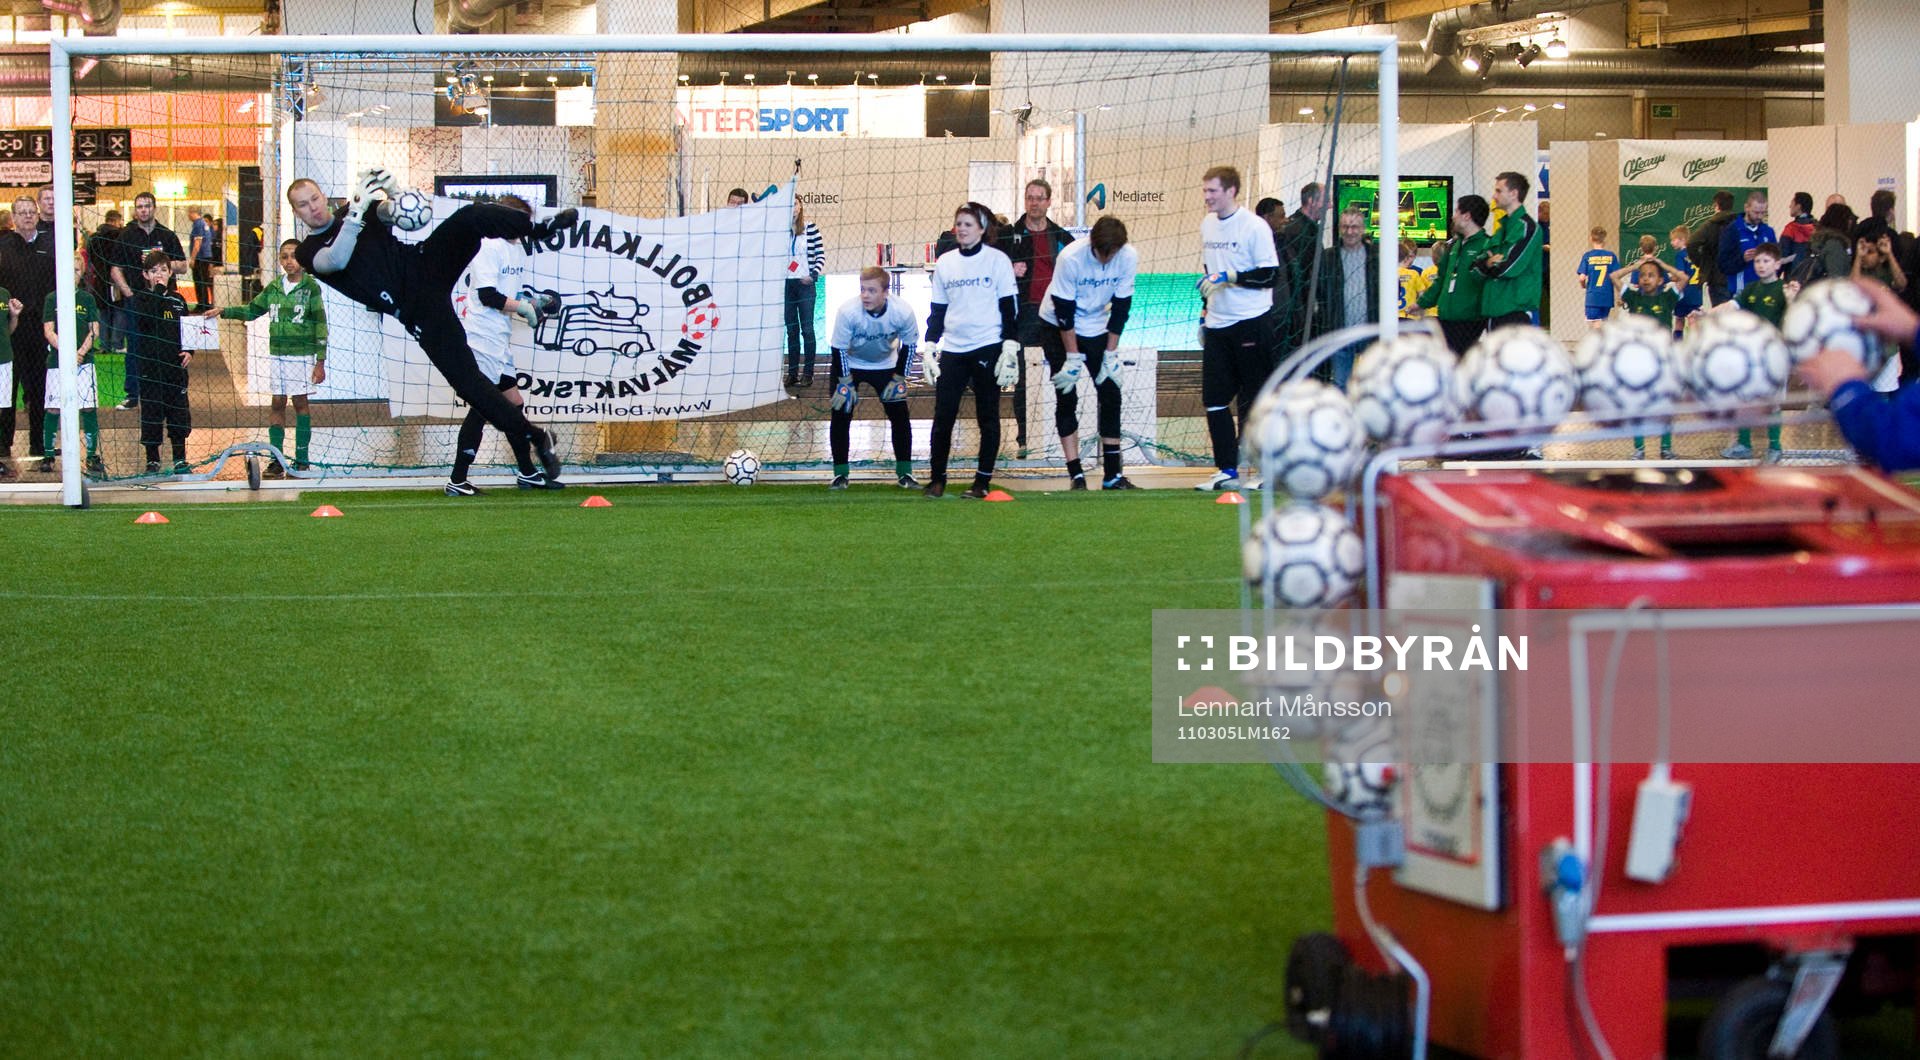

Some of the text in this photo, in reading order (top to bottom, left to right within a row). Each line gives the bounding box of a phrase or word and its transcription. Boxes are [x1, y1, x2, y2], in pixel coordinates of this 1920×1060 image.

[675, 108, 849, 132] NTERSPORT
[797, 192, 839, 204] ediatec
[1112, 190, 1165, 202] Mediatec
[1594, 265, 1608, 287] 7
[292, 305, 305, 323] 2
